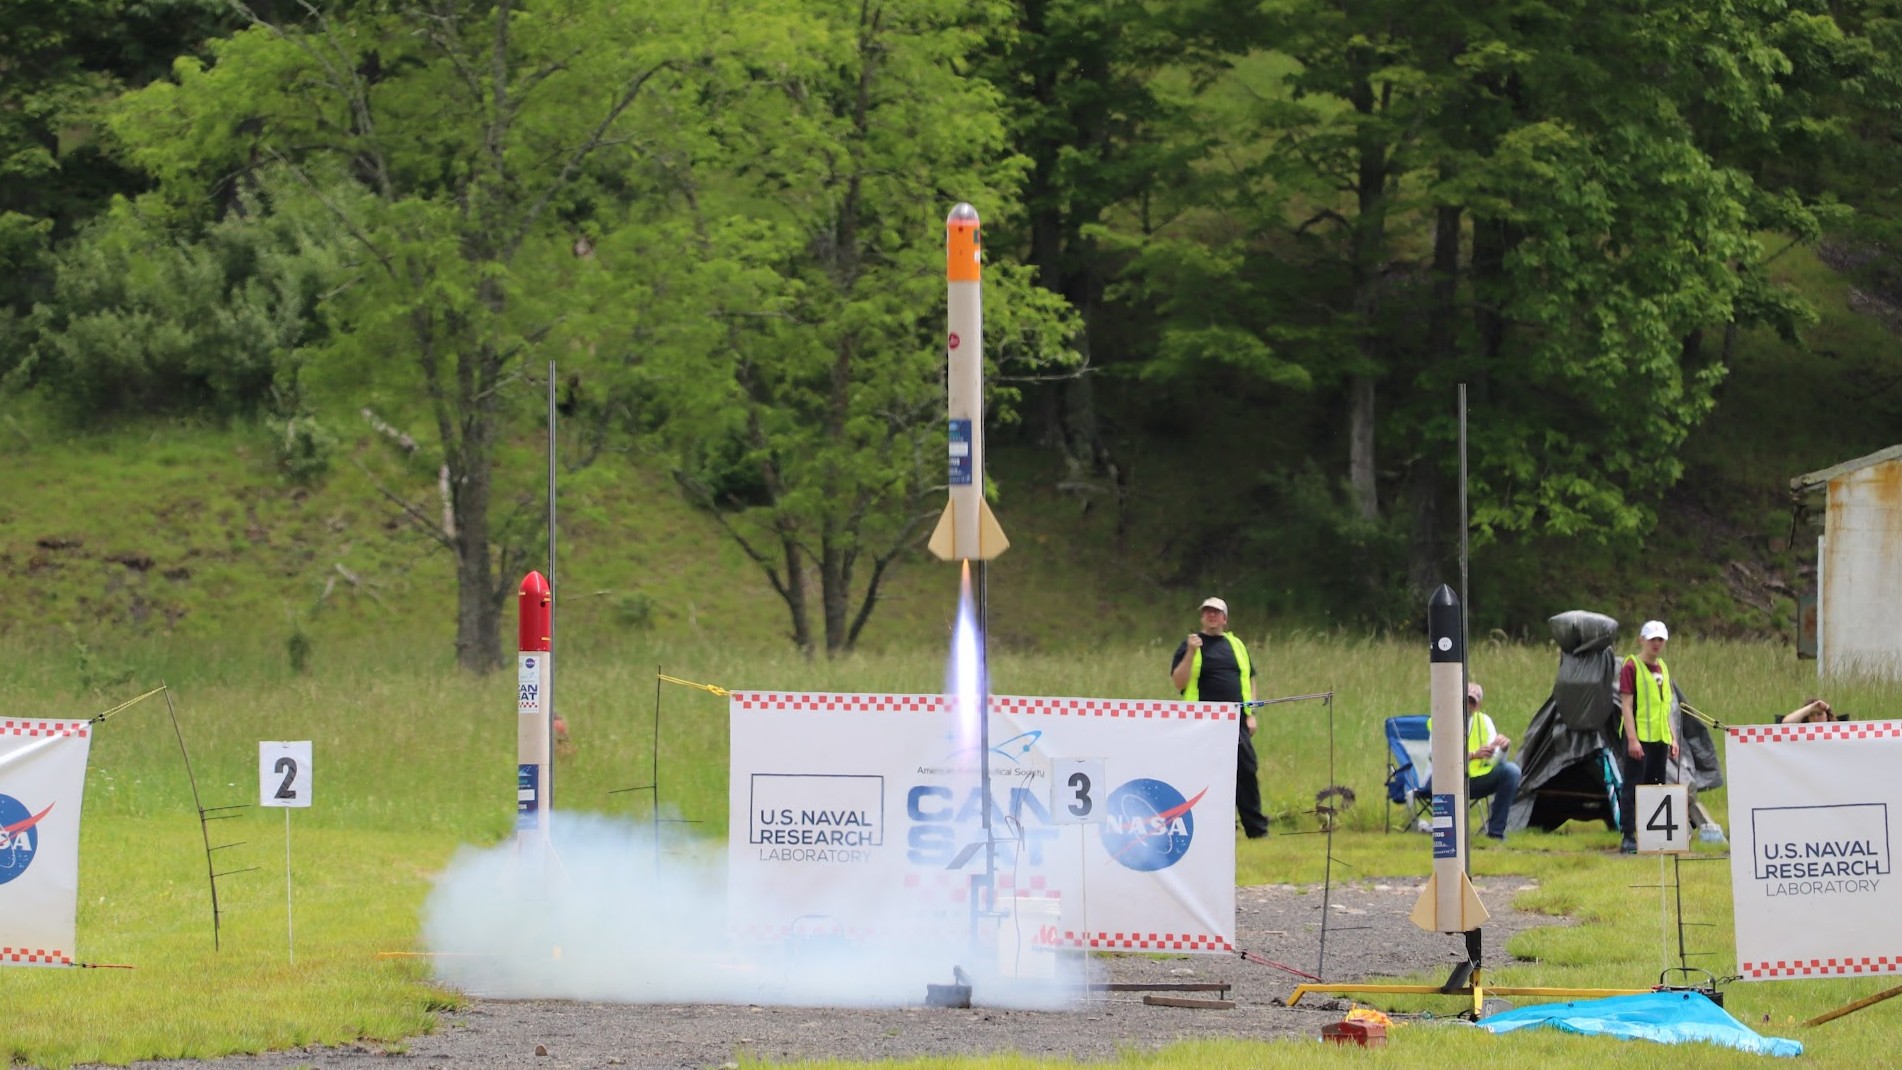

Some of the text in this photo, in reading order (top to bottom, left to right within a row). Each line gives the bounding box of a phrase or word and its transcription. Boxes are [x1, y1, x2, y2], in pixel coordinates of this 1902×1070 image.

[273, 757, 298, 799] 2
[1067, 772, 1093, 817] 3
[760, 809, 873, 827] U.S. NAVAL
[1106, 814, 1189, 837] NASA
[1646, 794, 1679, 841] 4
[760, 829, 873, 846] RESEARCH
[759, 848, 872, 863] LABORATORY
[1764, 840, 1878, 860] U.S. NAVAL
[1765, 860, 1880, 879] RESEARCH
[1765, 879, 1880, 897] LABORATORY
